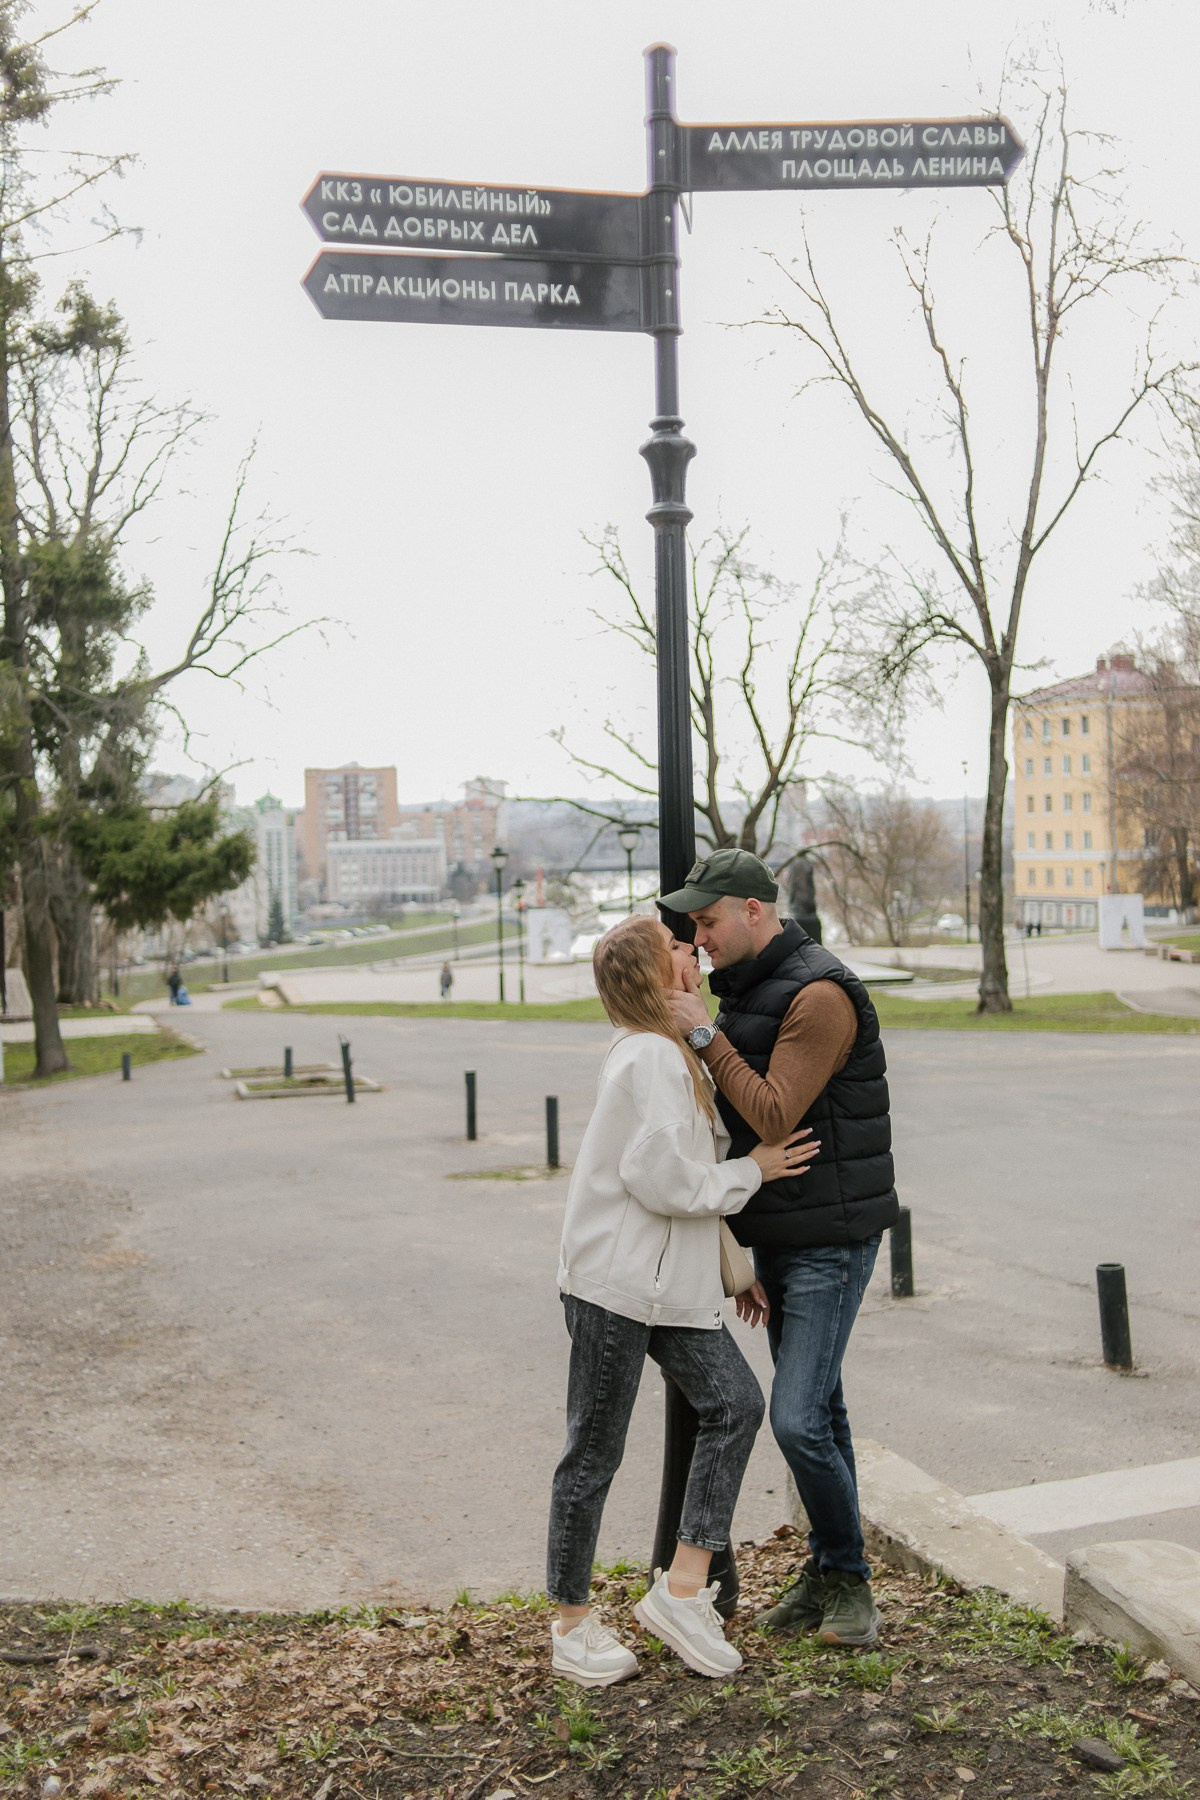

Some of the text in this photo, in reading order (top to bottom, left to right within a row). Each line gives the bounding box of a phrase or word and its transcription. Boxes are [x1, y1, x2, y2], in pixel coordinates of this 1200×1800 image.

[708, 124, 1006, 151] АЛЛЕЯ ТРУДОВОЙ СЛАВЫ
[782, 156, 1004, 179] ПЛОЩАДЬ ЛЕНИНА
[320, 180, 552, 215] ККЗ « ЮБИЛЕЙНЫЙ»
[322, 212, 539, 245] САД ДОБРЫХ ДЕЛ
[323, 273, 581, 304] АТТРАКЦИОНЫ ПАРКА
